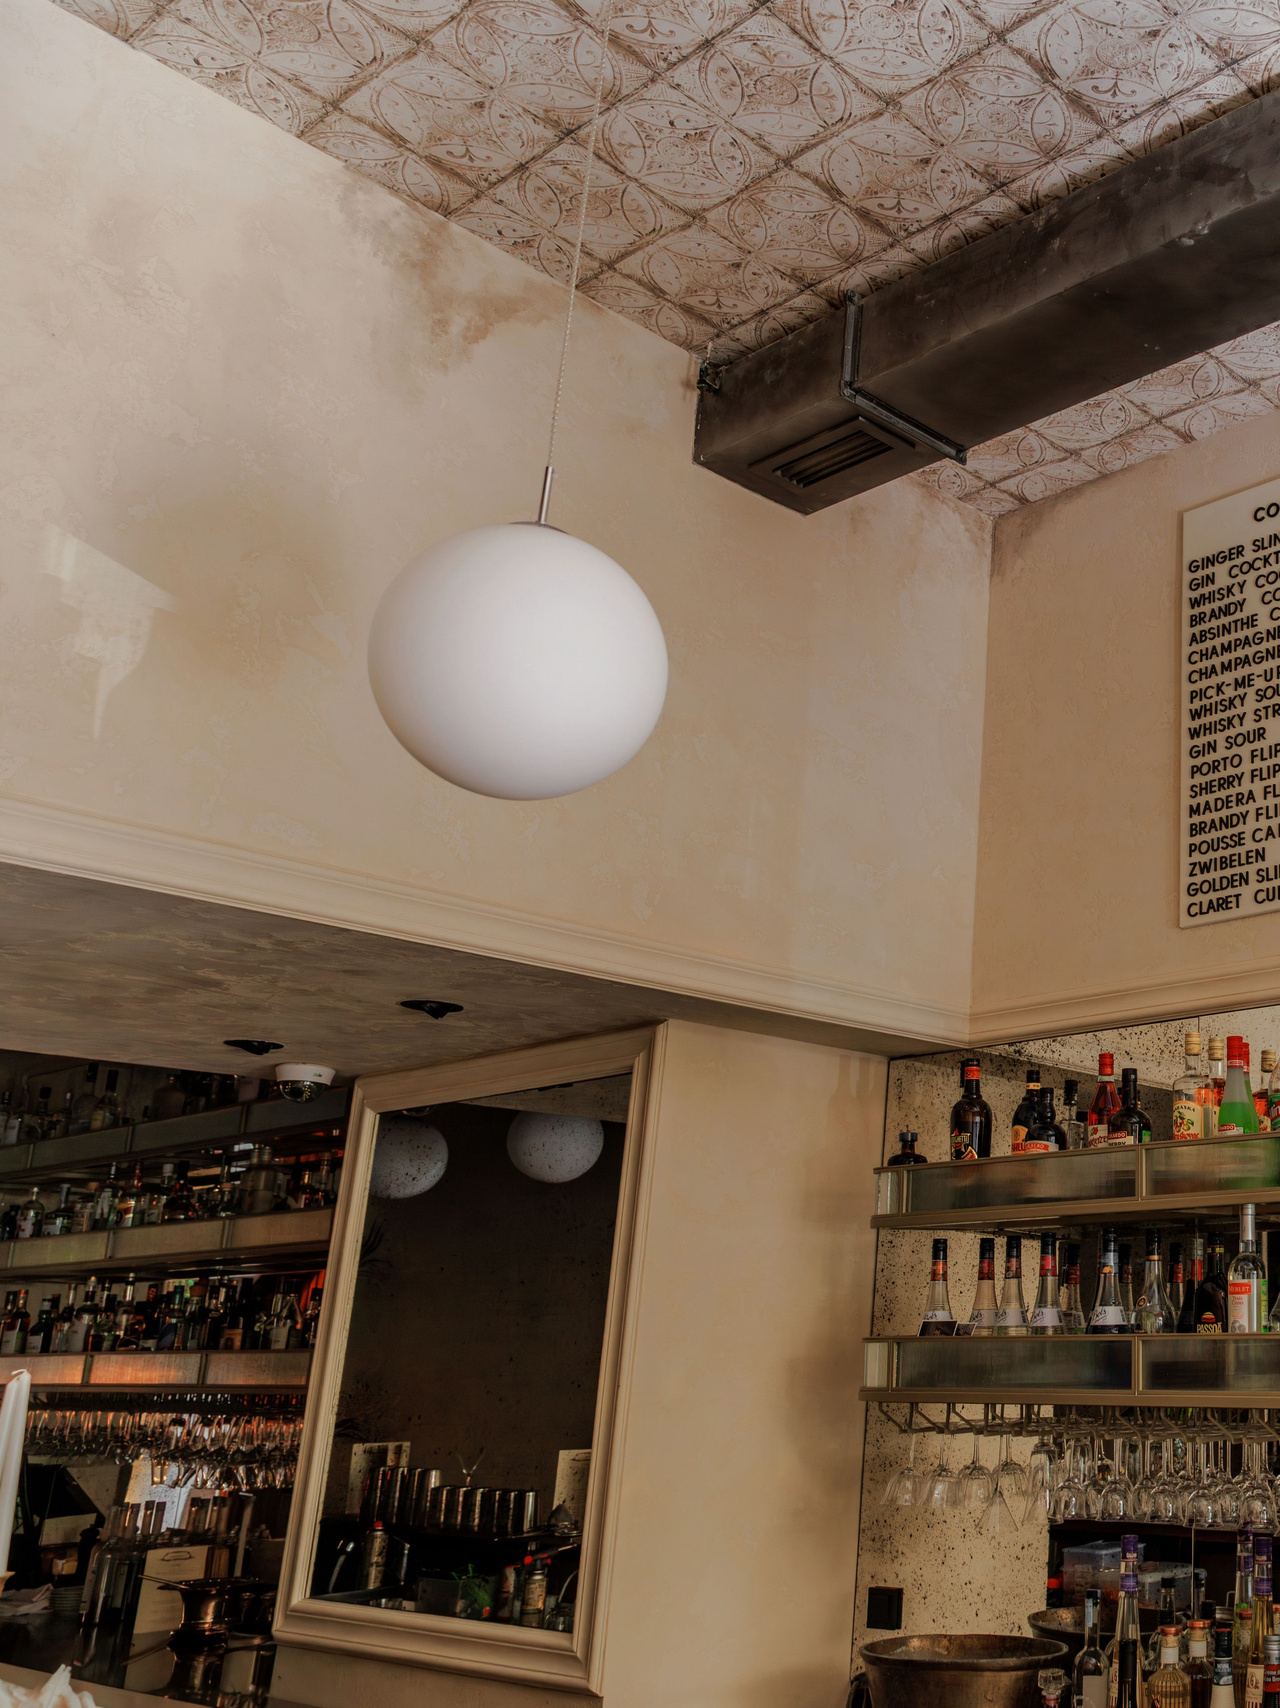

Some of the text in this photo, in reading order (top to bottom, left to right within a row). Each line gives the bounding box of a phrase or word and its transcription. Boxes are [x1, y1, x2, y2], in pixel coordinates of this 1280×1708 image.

[1189, 545, 1244, 573] GINGER
[1189, 572, 1215, 591] GIN
[1189, 580, 1246, 609] WHISKY
[1190, 598, 1246, 628] BRANDY
[1189, 614, 1258, 646] ABSINTHE
[1189, 692, 1247, 721] WHISKY
[1188, 712, 1246, 740] WHISKY
[1189, 740, 1216, 759] GIN
[1225, 727, 1266, 750] SOUR
[1191, 754, 1242, 779] PORTO
[1190, 772, 1244, 798] SHERRY
[1251, 764, 1280, 783] FLIP
[1189, 790, 1256, 818] MADERA
[1190, 810, 1249, 837] BRANDY
[1189, 831, 1245, 857] POUSSE
[1189, 847, 1265, 877] ZWIBELEN
[1187, 871, 1249, 897] GOLDEN
[1187, 894, 1241, 917] CLARET
